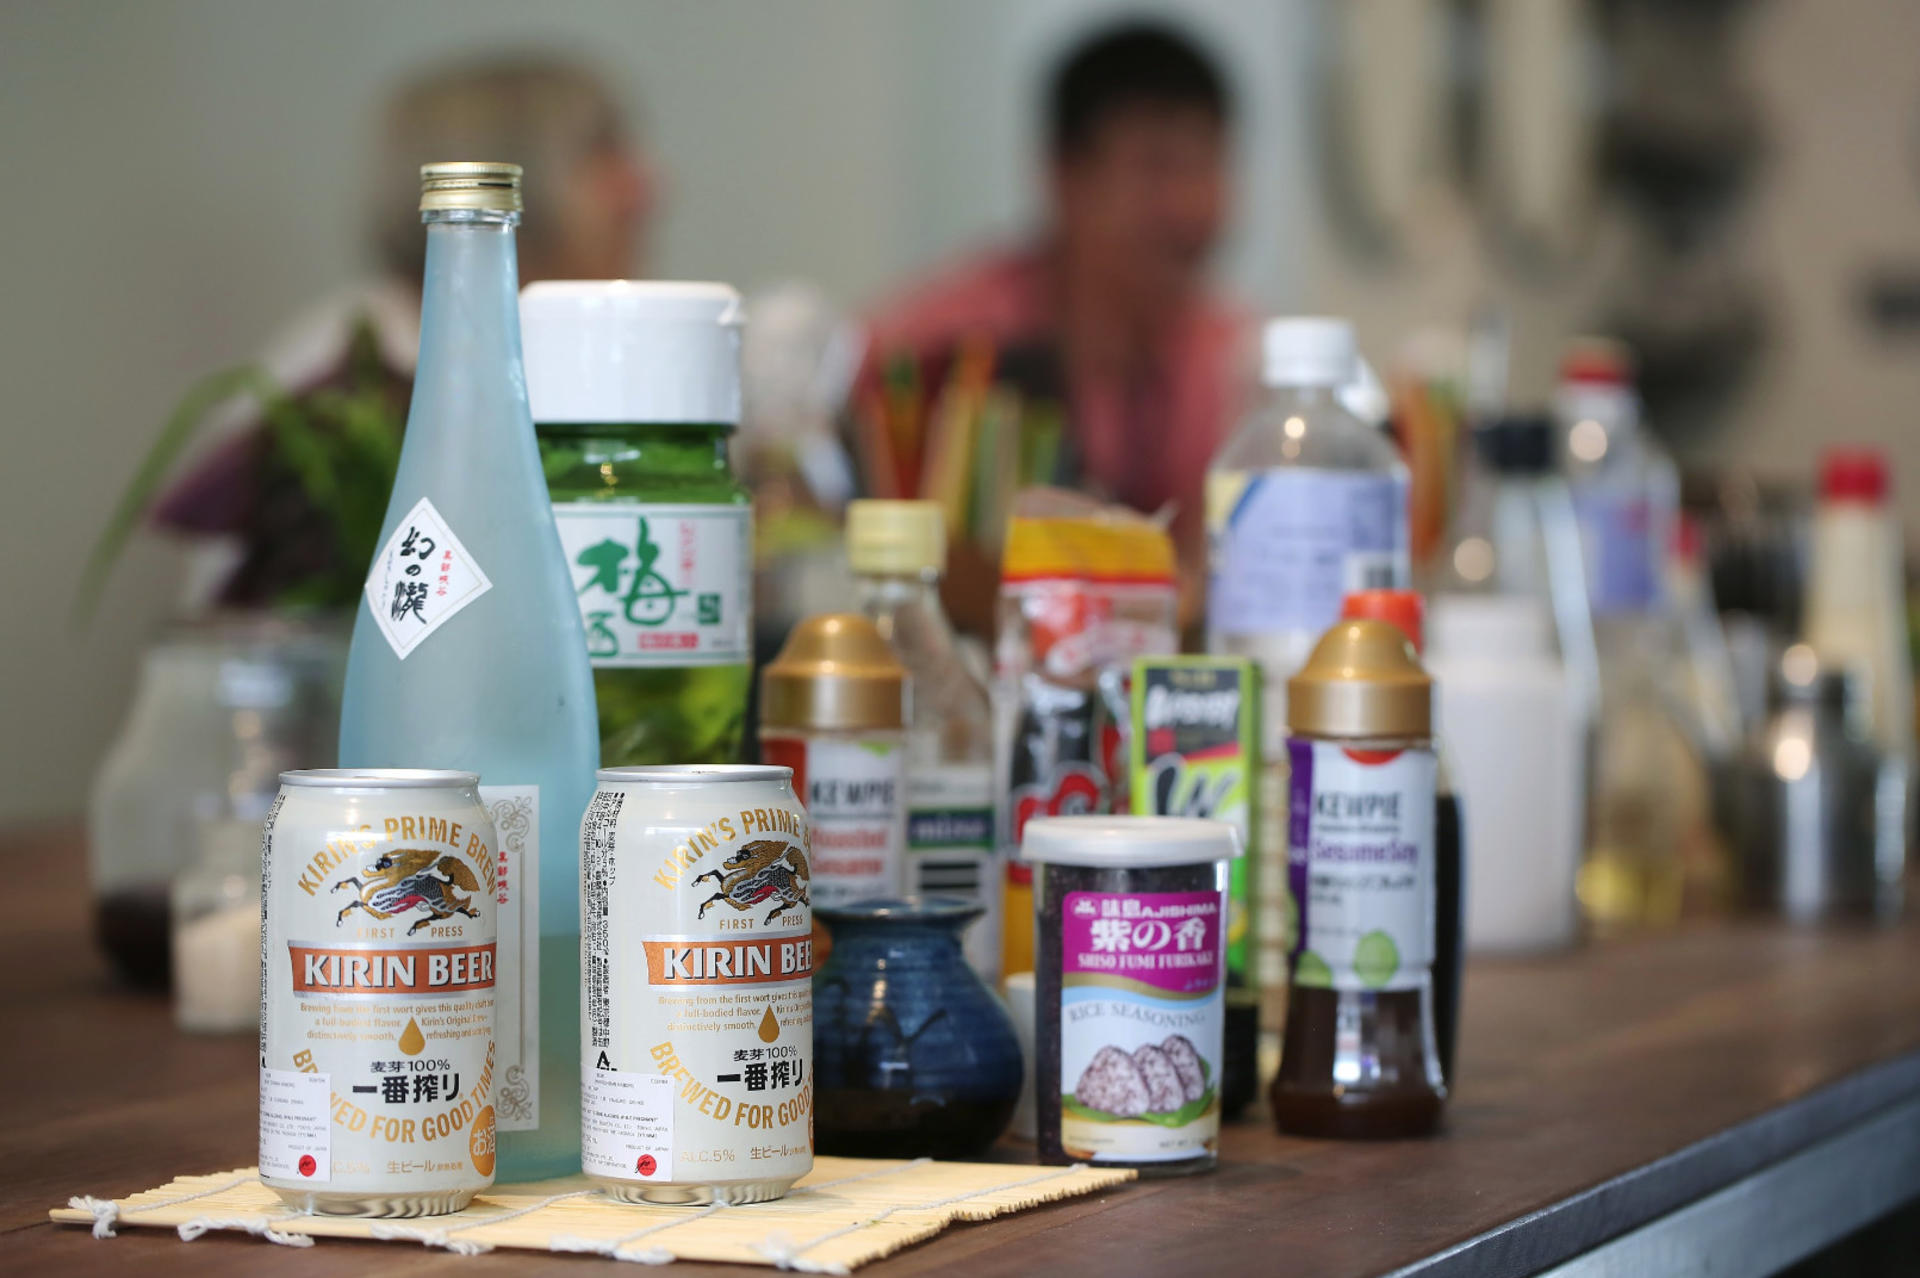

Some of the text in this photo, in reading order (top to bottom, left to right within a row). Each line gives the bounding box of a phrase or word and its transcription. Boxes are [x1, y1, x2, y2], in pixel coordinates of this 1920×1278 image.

[575, 516, 690, 626] 梅
[1317, 791, 1402, 818] KEWPIE
[384, 815, 463, 849] PRIME
[466, 832, 496, 896] BREW
[653, 817, 736, 891] KIRIN'S
[740, 808, 800, 837] PRIME
[357, 926, 463, 939] FIRST PRESS
[719, 914, 803, 930] FIRST PRESS
[1090, 917, 1206, 952] 紫の香
[304, 950, 493, 988] KIRIN BEER
[663, 940, 812, 980] KIRIN BEE
[720, 994, 733, 1004] the
[735, 993, 750, 1003] first
[1069, 1002, 1205, 1028] RICE SEASONING
[422, 1017, 445, 1026] Kirin's
[352, 1072, 460, 1105] 一番搾り
[370, 1115, 415, 1144] FOR
[422, 1101, 474, 1143] GOOD
[471, 1039, 496, 1108] TIMES
[650, 1041, 731, 1121] BREWED
[734, 1103, 773, 1130] FOR
[717, 1058, 803, 1092] 一番搾り
[387, 1160, 435, 1174] 生ビール
[750, 1144, 788, 1160] 生ビール
